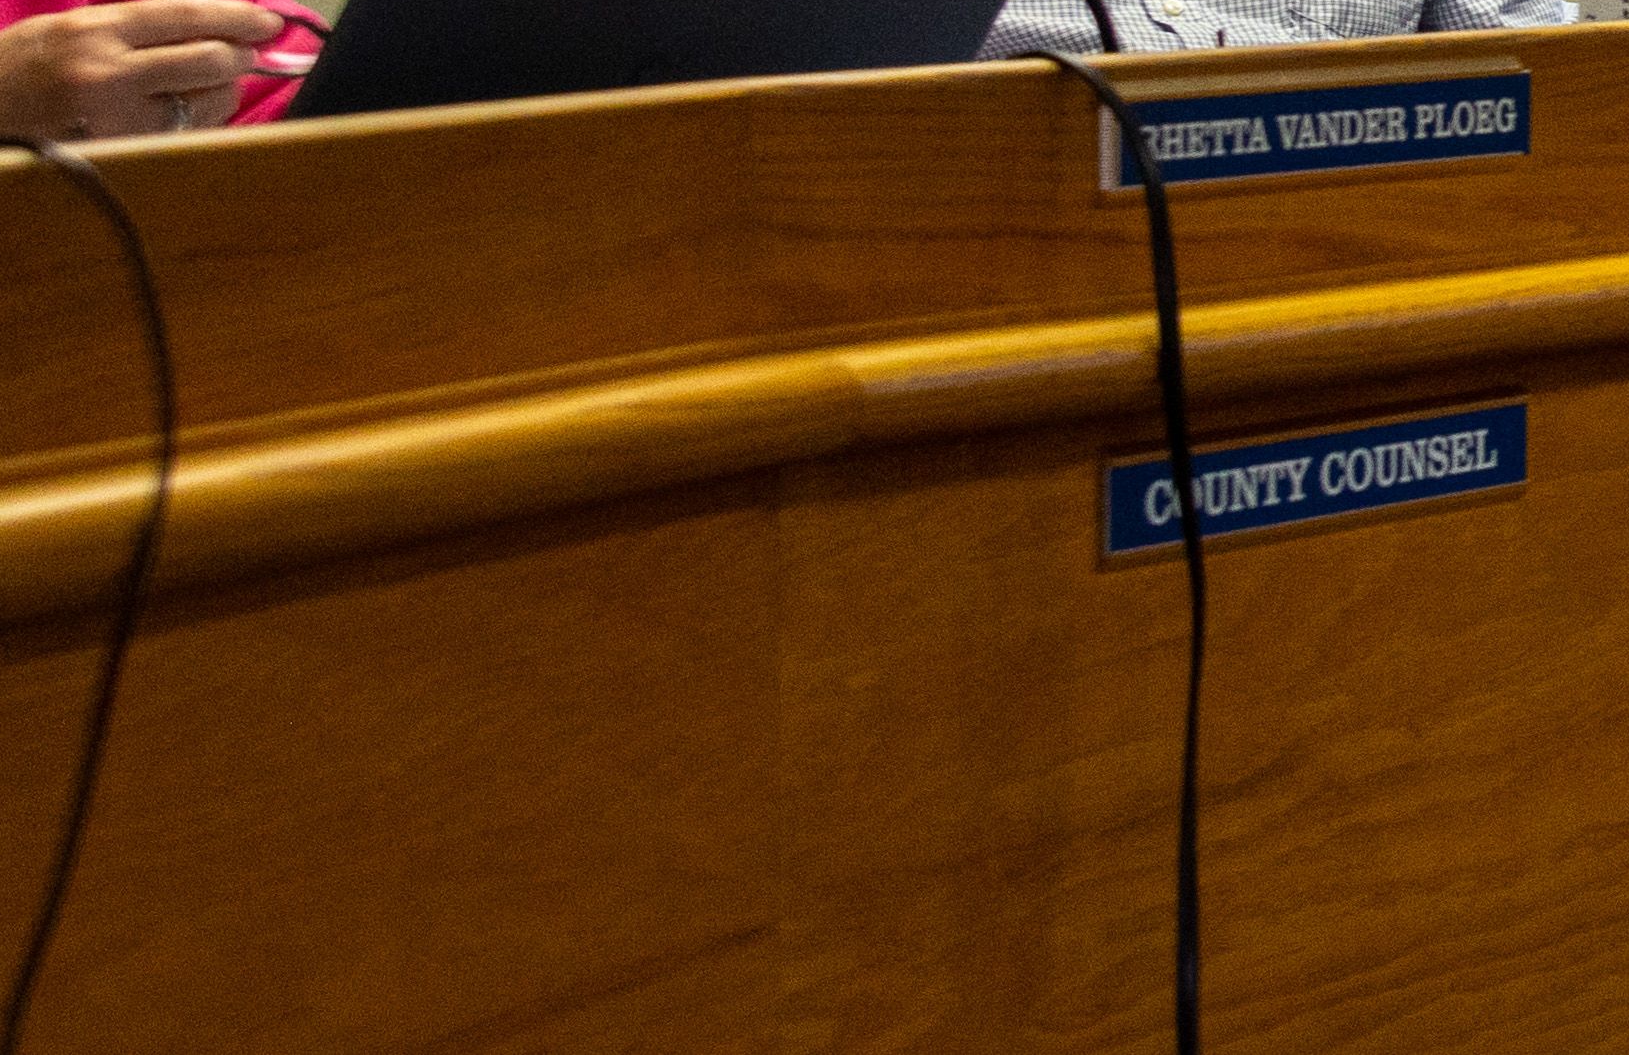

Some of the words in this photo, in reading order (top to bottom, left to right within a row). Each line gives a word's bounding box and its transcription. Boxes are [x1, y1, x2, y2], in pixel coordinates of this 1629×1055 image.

[1275, 104, 1407, 151] VANDER
[1414, 97, 1518, 140] PLOEG
[1318, 428, 1499, 497] COUNSEL
